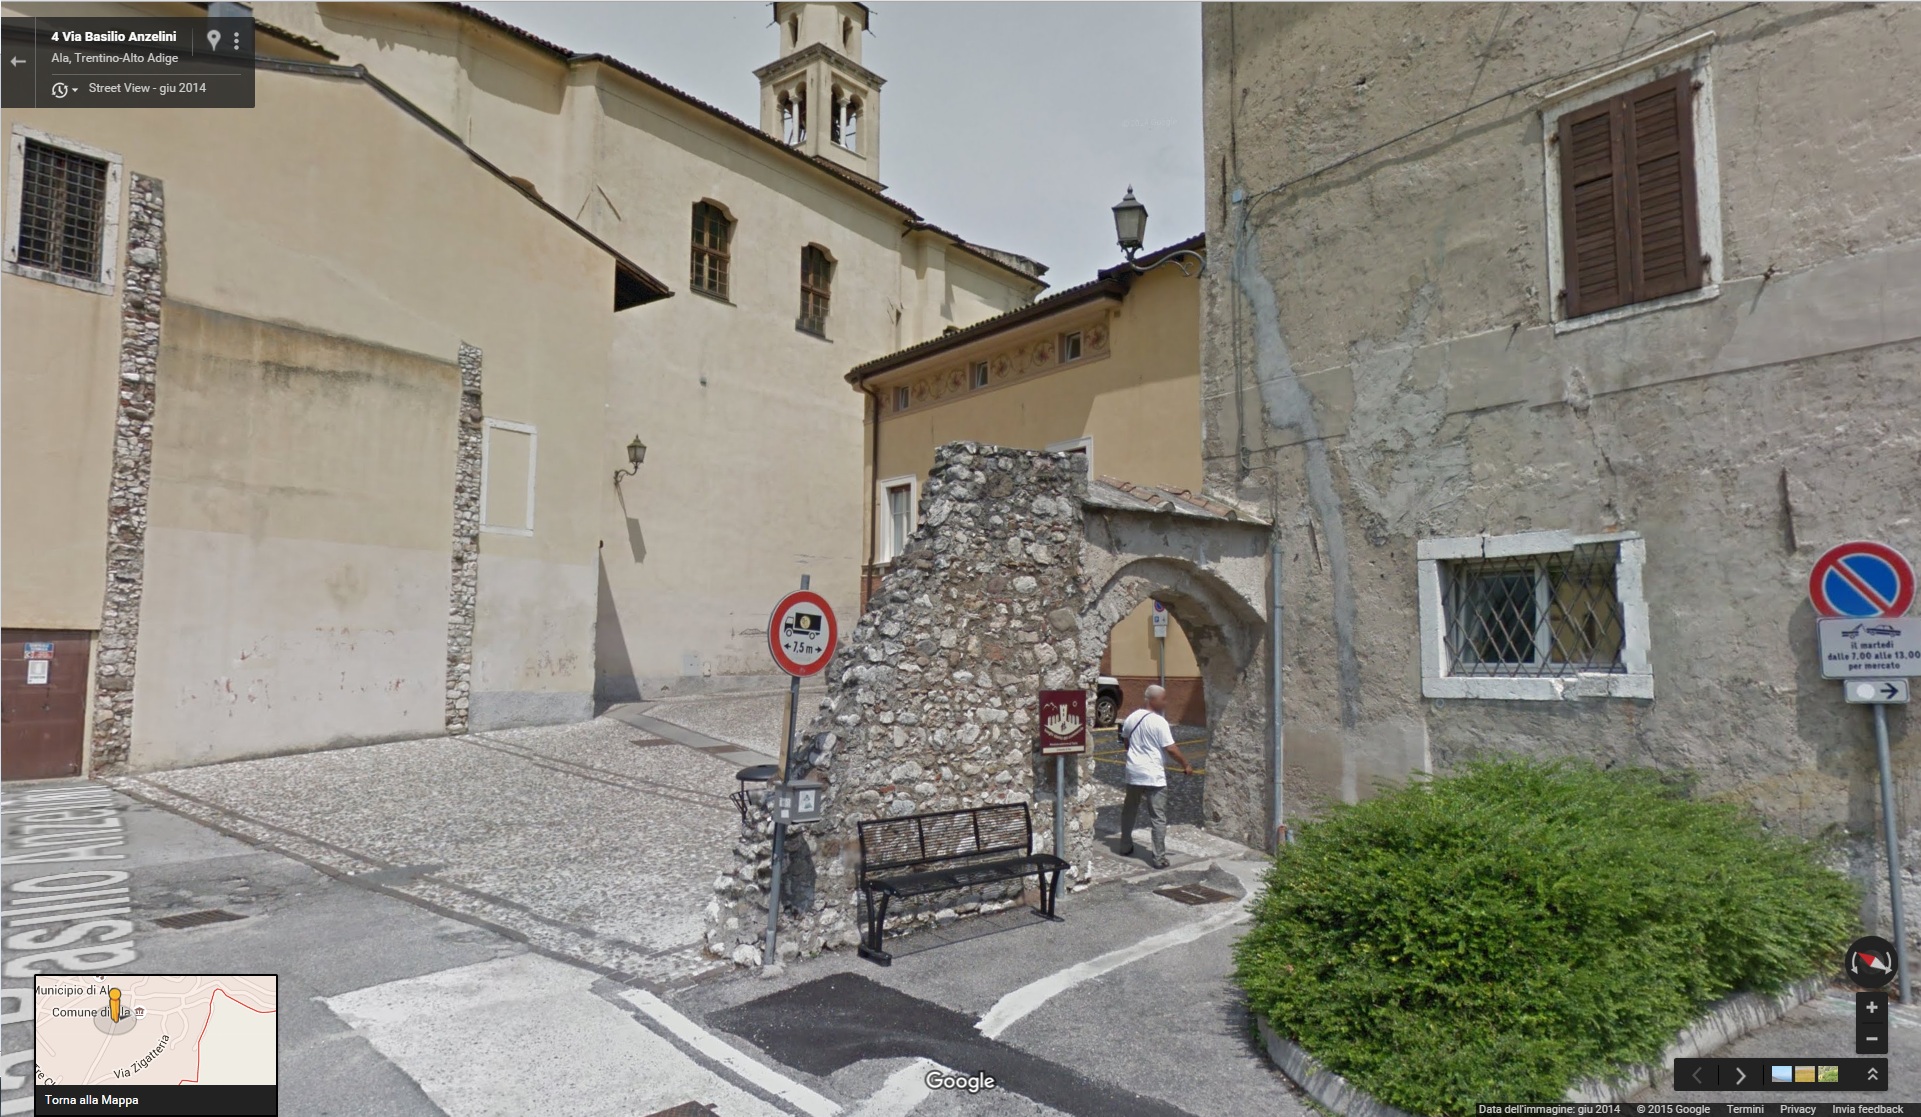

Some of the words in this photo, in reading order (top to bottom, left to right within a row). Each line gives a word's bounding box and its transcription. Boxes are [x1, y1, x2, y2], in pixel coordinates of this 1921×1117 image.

[806, 645, 813, 654] m
[1851, 641, 1858, 650] il
[1827, 652, 1850, 661] dalle
[1874, 651, 1893, 660] alle
[1848, 662, 1862, 672] per
[1864, 662, 1901, 670] mercato
